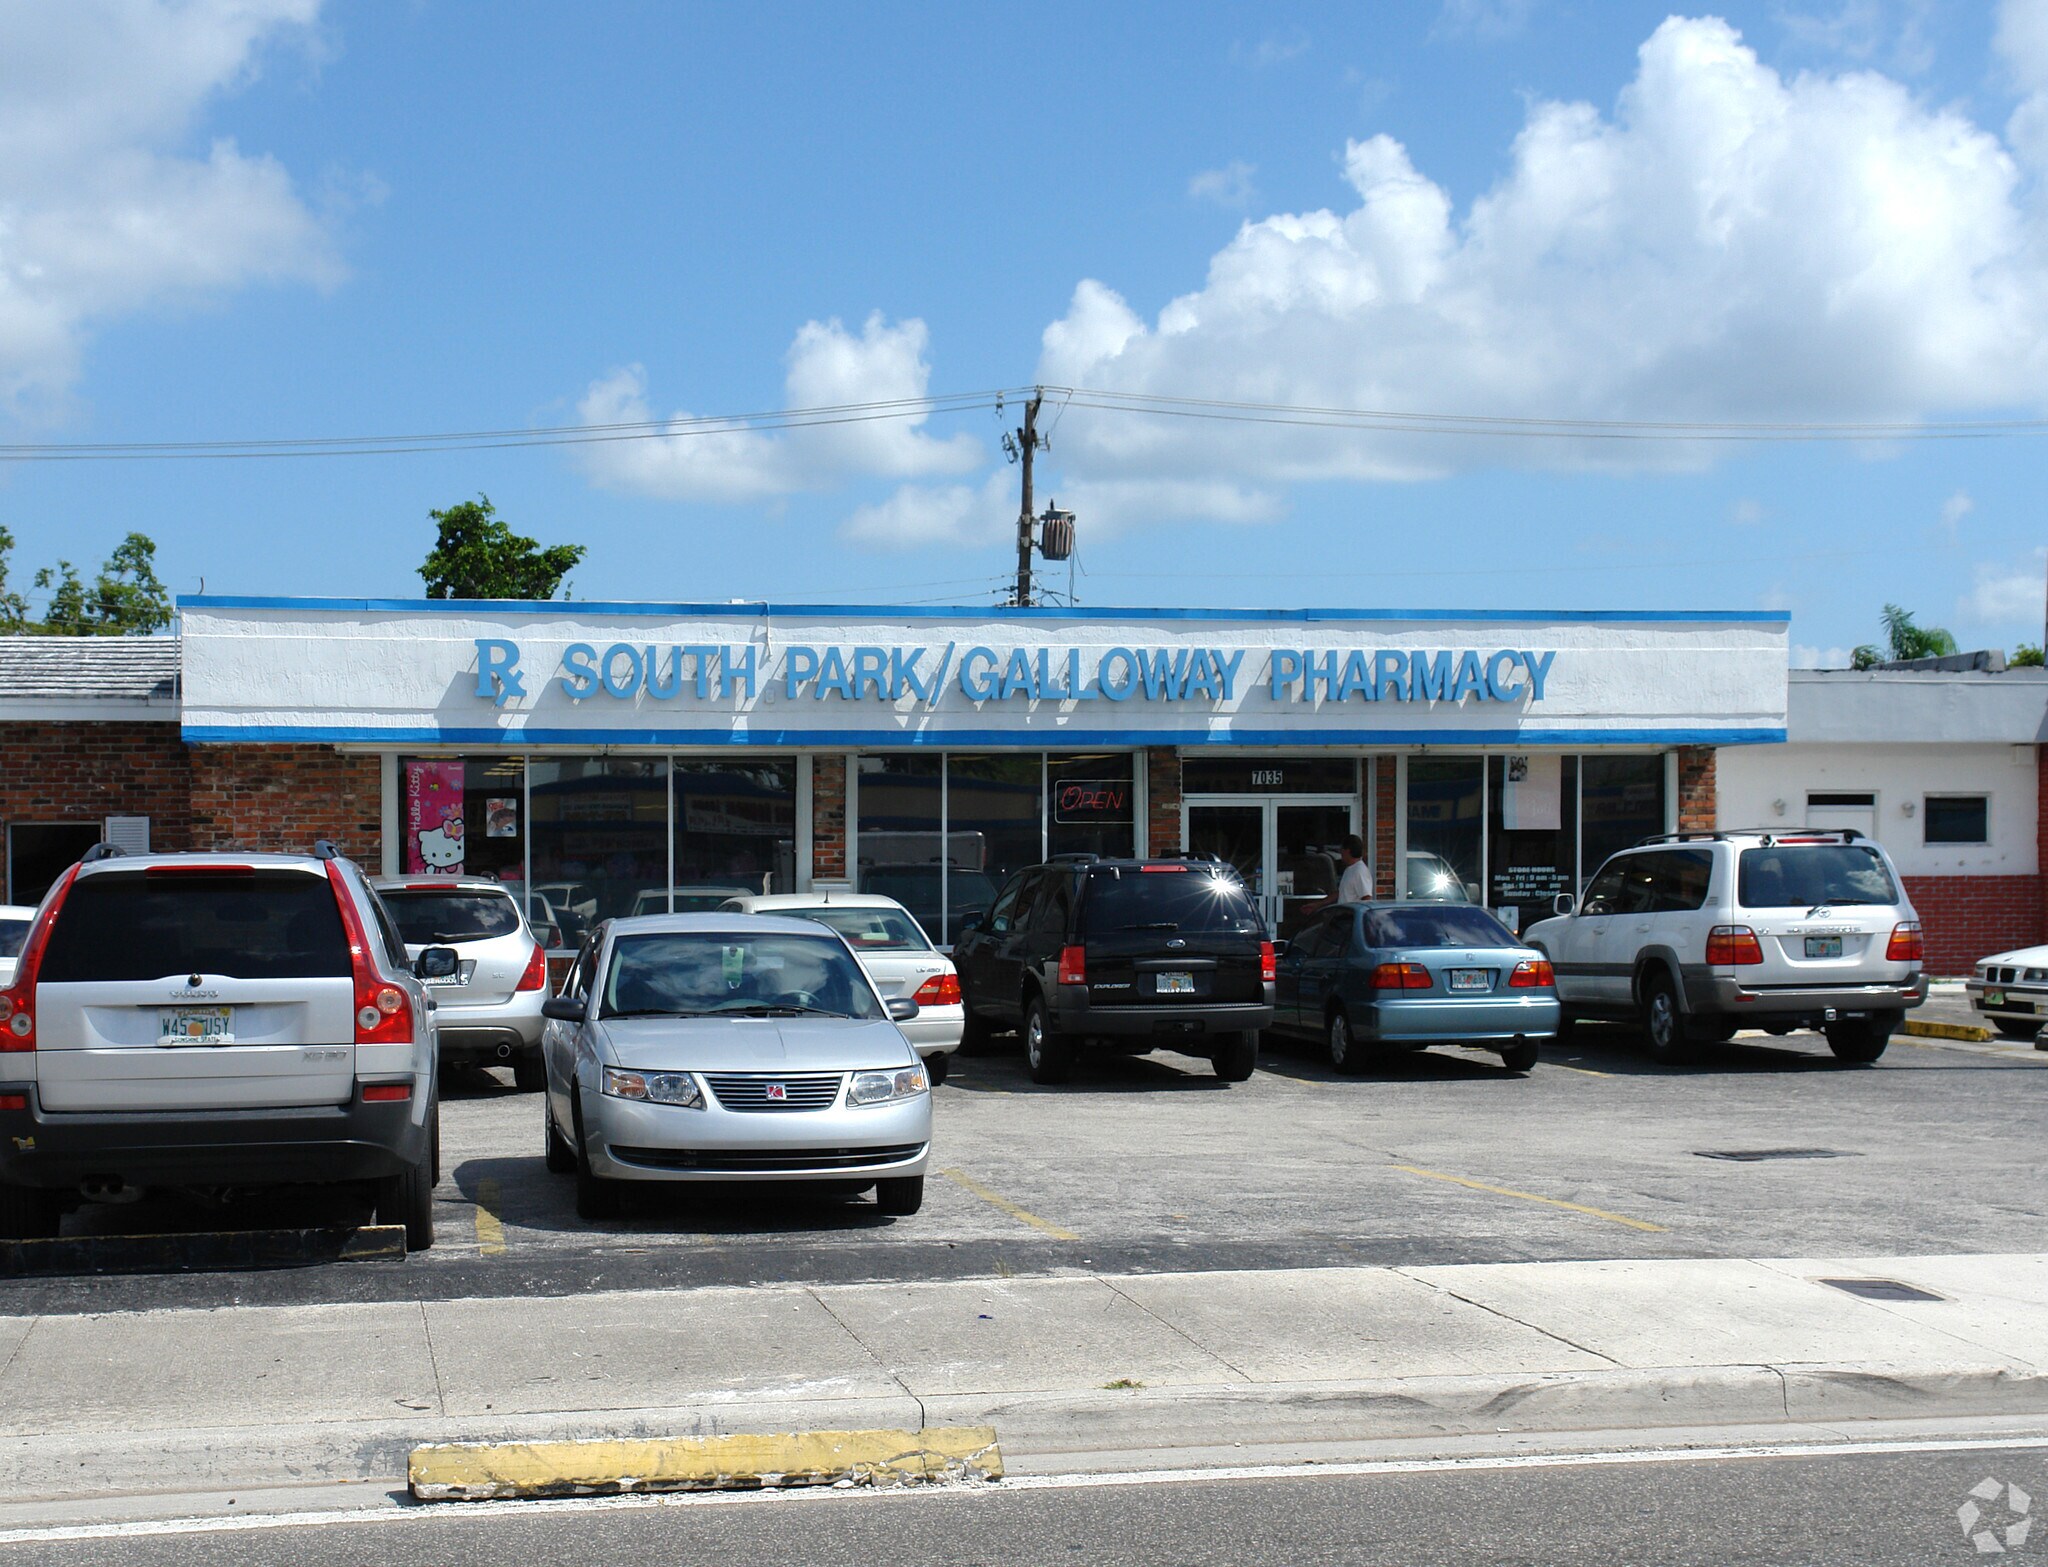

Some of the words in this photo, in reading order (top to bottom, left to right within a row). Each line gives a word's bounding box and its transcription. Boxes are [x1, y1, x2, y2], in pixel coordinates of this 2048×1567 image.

[561, 643, 756, 700] SOUTH
[1271, 648, 1557, 702] PHARMACY
[409, 765, 424, 797] Kitty
[1252, 771, 1282, 784] 7035
[1061, 786, 1124, 810] OPEN
[410, 799, 421, 831] Hello
[205, 1017, 230, 1035] USY
